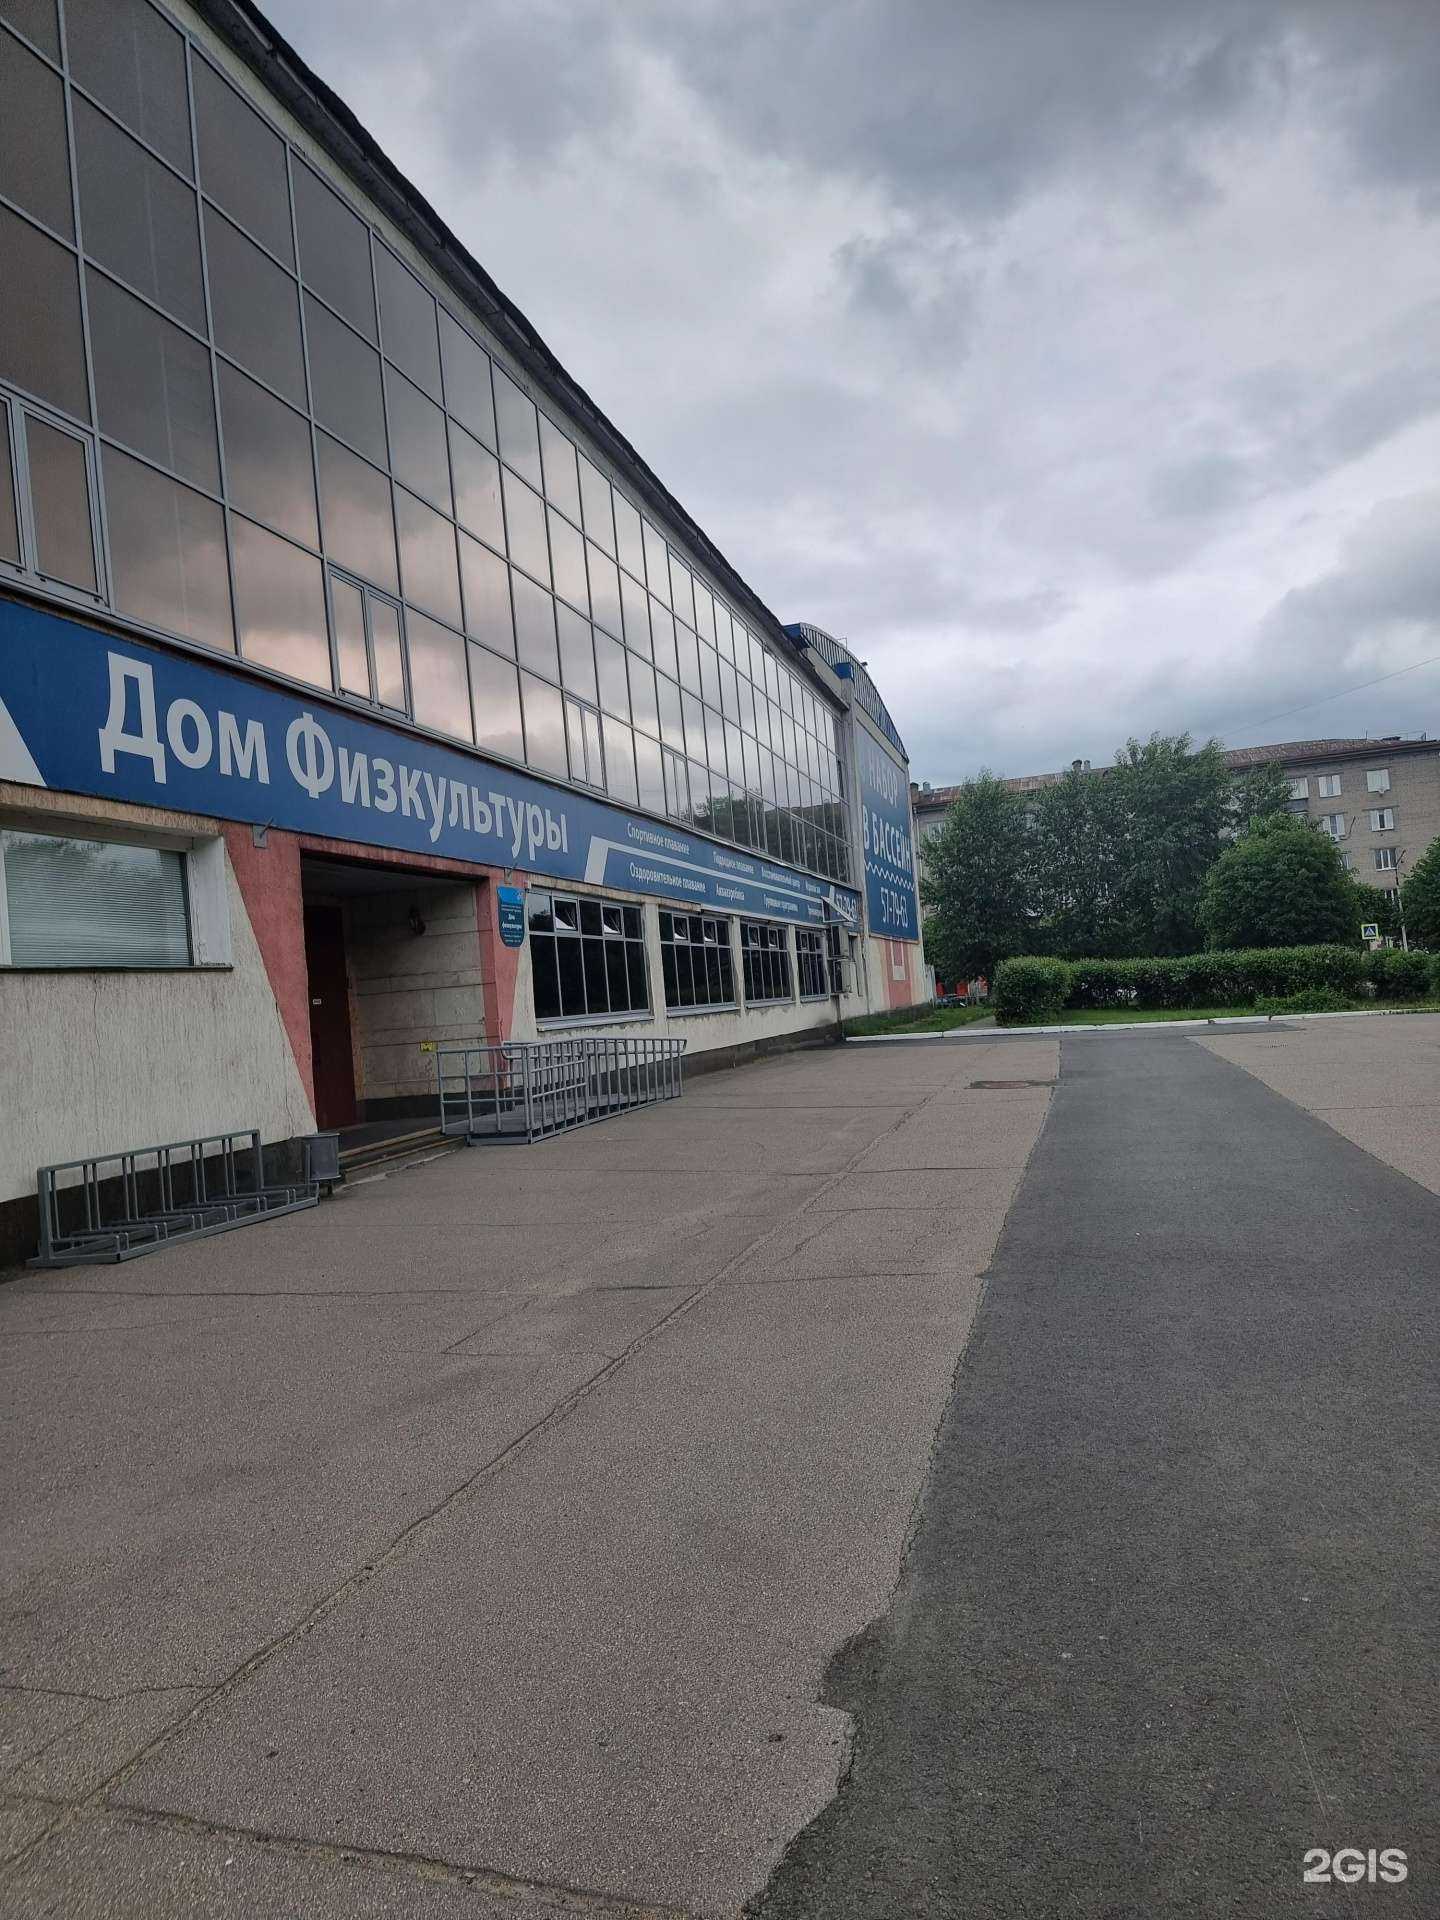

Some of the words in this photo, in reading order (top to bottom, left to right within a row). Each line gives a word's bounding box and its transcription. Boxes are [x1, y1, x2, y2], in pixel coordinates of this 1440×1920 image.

[98, 651, 270, 784] Дом
[285, 711, 569, 861] Физкультуры
[869, 762, 898, 808] НАБОР
[627, 822, 664, 847] Спортивное
[664, 837, 690, 855] плавание
[862, 804, 870, 849] В
[872, 811, 912, 875] БАССЕЙН
[629, 861, 683, 888] Оздоровительное
[682, 878, 706, 893] плавание
[880, 886, 908, 928] 57-79-63
